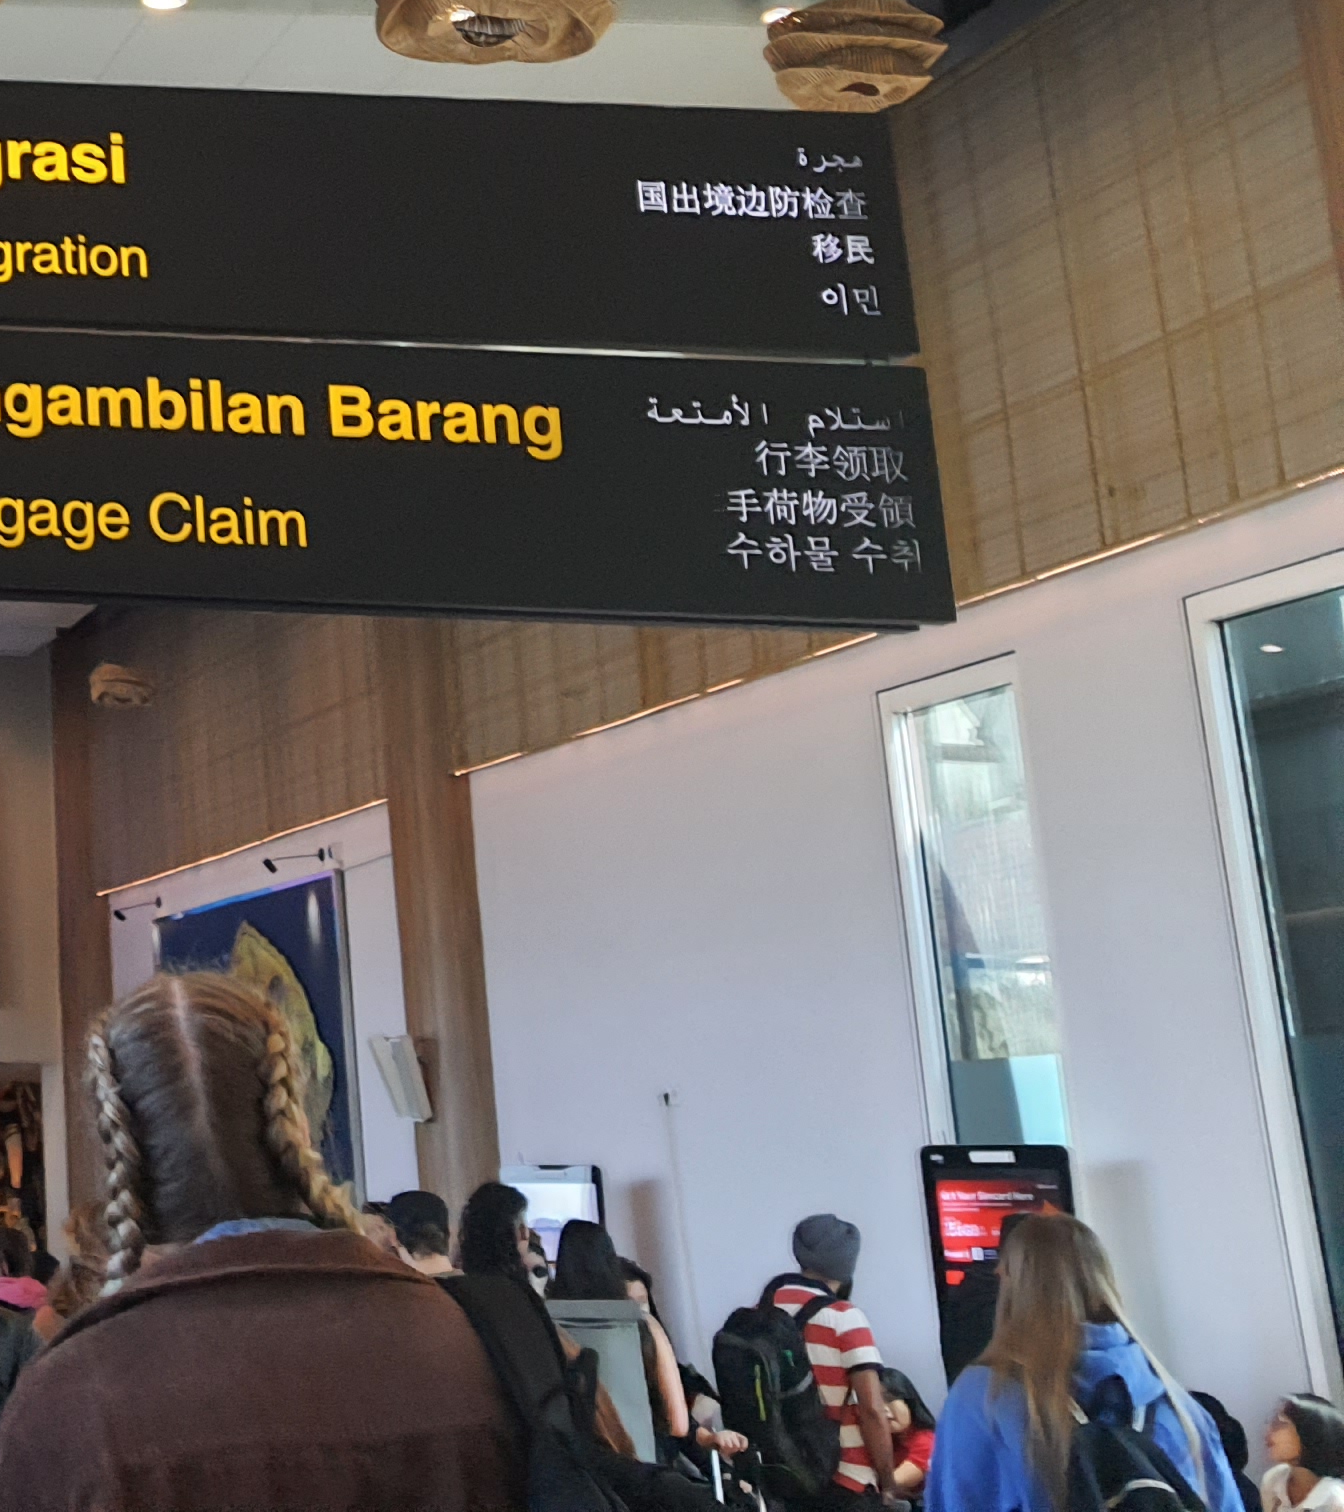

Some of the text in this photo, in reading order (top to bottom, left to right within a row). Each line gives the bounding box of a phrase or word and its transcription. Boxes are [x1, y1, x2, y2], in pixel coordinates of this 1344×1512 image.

[637, 179, 865, 219] 国出境边防检查
[811, 233, 875, 265] 移民
[821, 282, 881, 316] 이민
[328, 384, 563, 461] Barang
[754, 439, 909, 483] 行李领取
[149, 491, 308, 548] Claim
[726, 488, 916, 528] 手荷物受領
[726, 531, 923, 574] 수하물 수취
